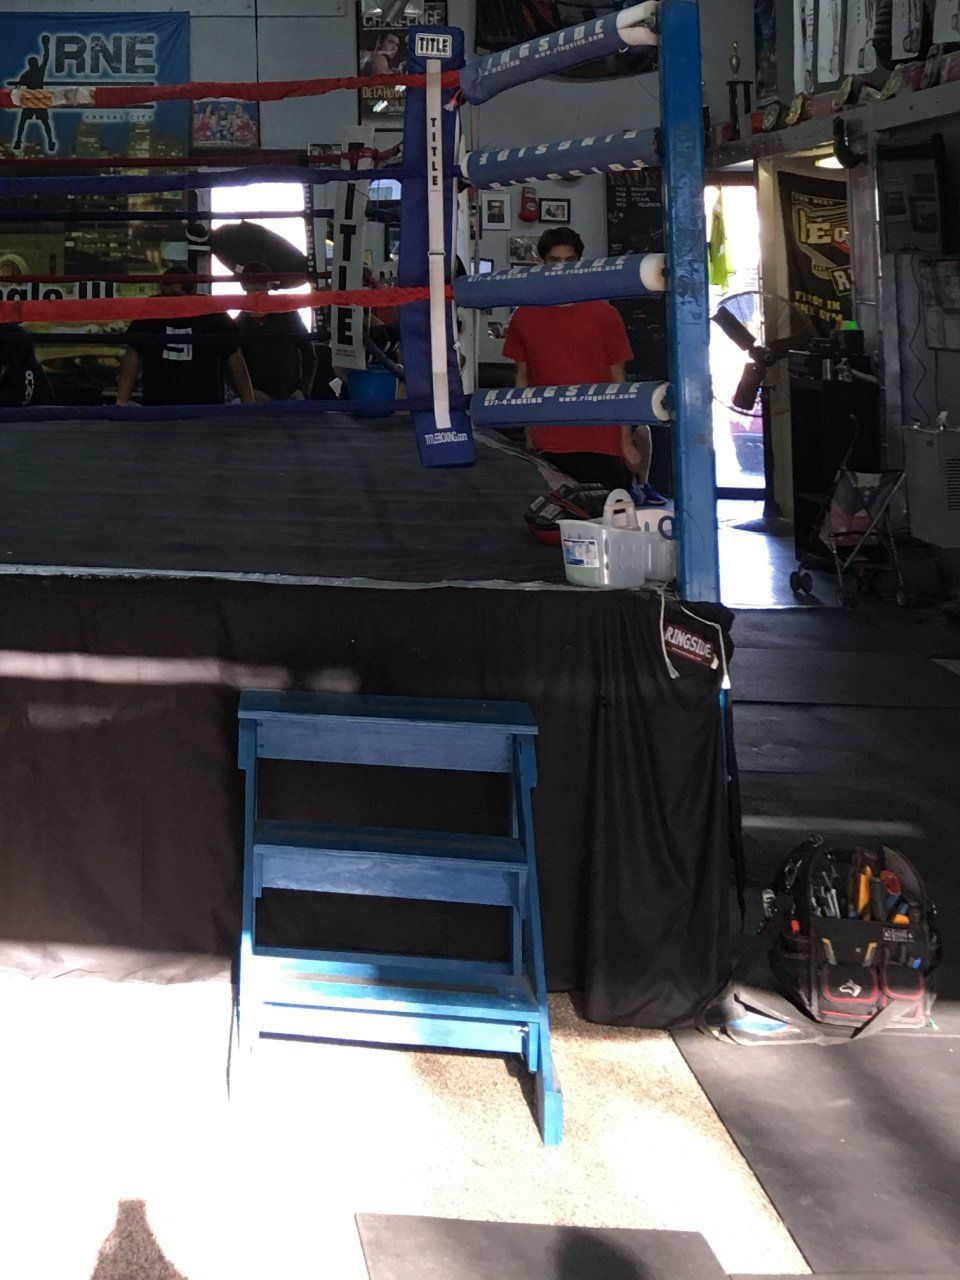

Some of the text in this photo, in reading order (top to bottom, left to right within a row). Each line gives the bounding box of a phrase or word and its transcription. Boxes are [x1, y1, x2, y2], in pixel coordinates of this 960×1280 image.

[54, 35, 156, 74] RNE
[430, 117, 439, 186] TITLE
[485, 383, 642, 401] RINGSIDE
[558, 393, 637, 403] www.ringside.com
[665, 625, 713, 659] RINGSIDE
